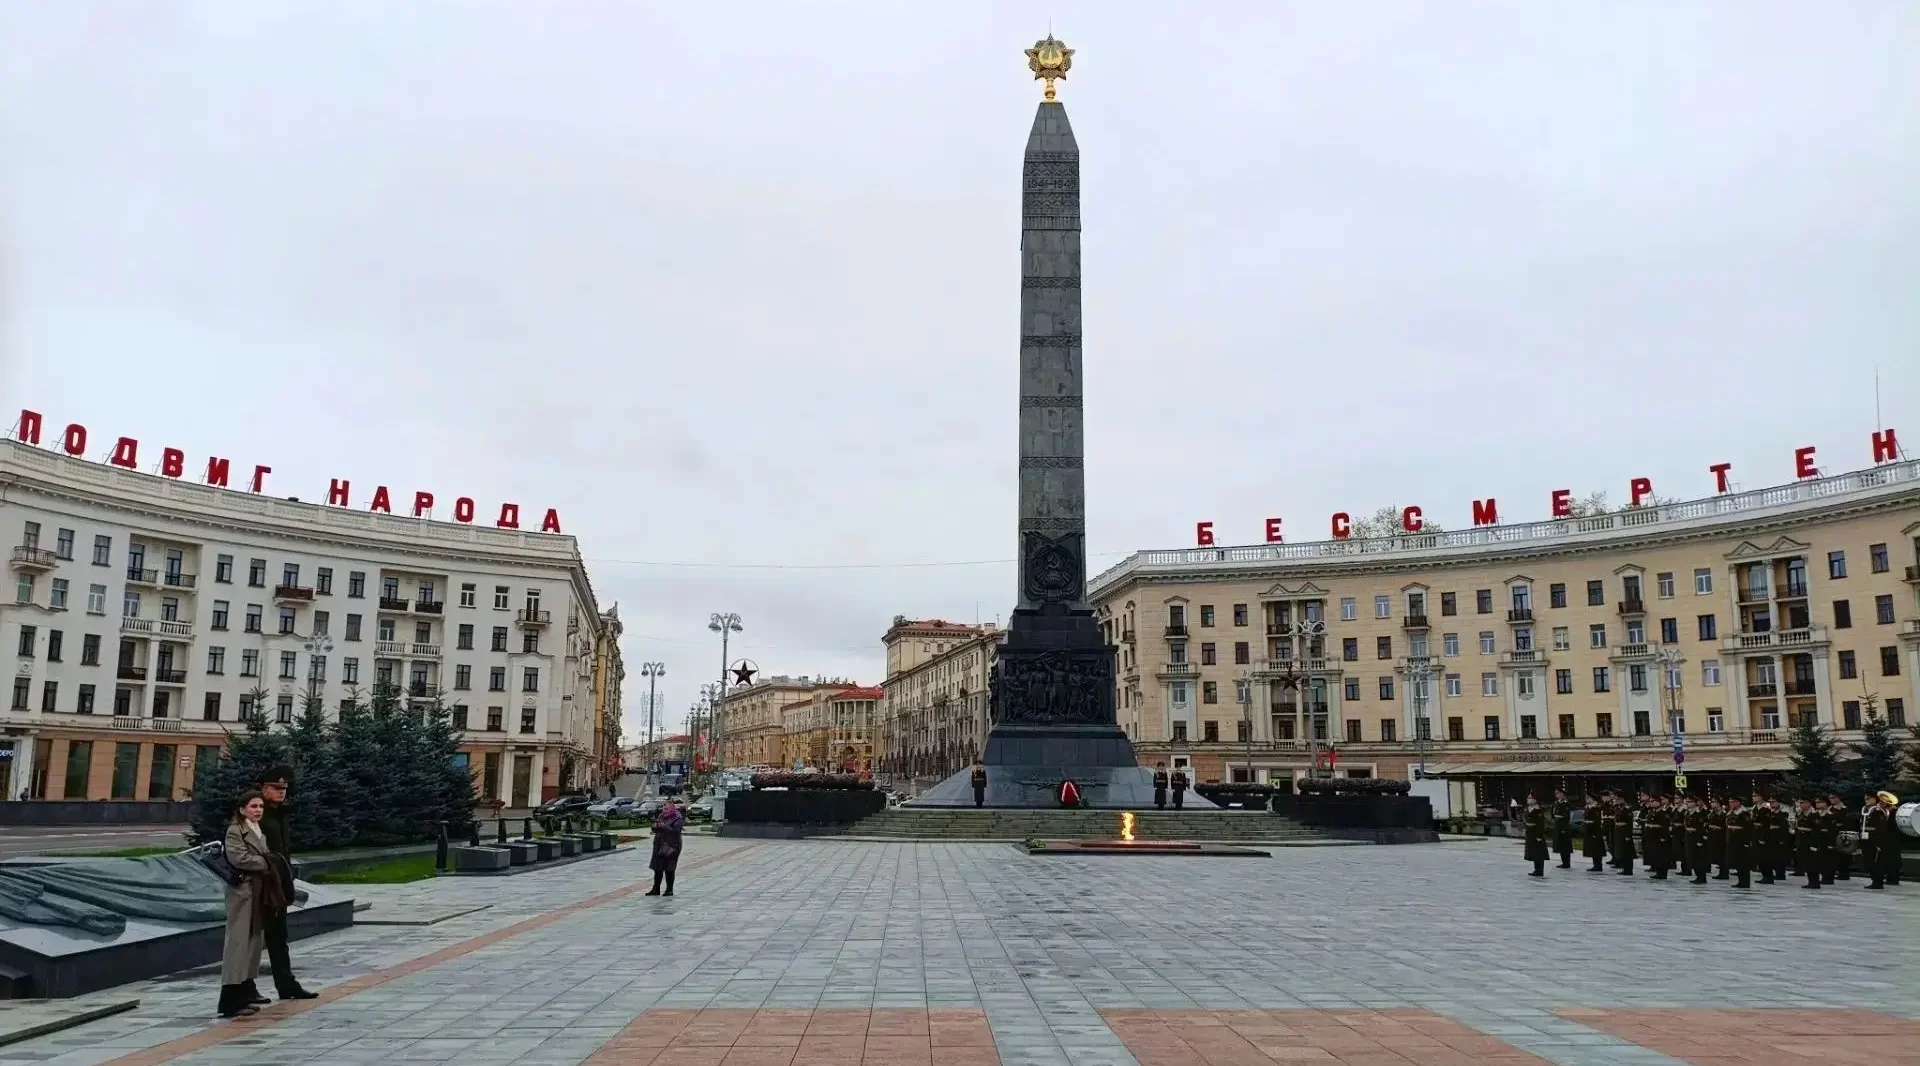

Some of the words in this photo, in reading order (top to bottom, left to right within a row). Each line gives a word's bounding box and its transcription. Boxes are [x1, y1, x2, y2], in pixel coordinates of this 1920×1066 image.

[19, 410, 271, 492] ПОДВИГ
[330, 478, 560, 533] НАРОДА
[1196, 429, 1896, 545] БЕССМЕРТЕН
